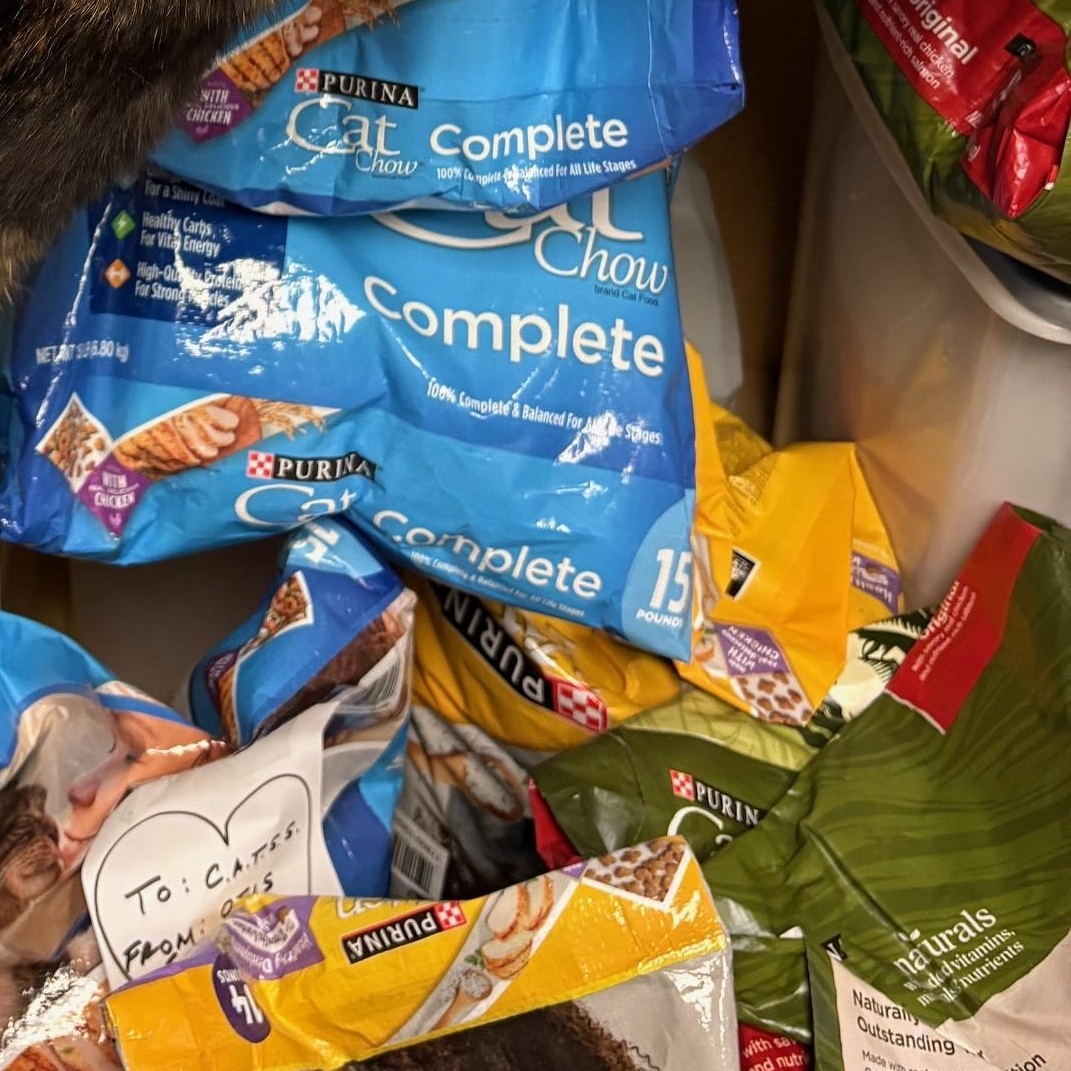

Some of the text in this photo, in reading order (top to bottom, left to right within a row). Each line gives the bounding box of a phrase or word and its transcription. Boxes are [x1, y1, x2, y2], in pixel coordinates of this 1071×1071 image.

[910, 55, 941, 89] salmon
[919, 41, 955, 79] chicken
[200, 89, 229, 103] WITH
[323, 73, 415, 107] PURINA
[186, 108, 231, 124] CHICKEN
[286, 97, 401, 156] Cat
[430, 114, 628, 161] Complete
[355, 148, 418, 175] Chow
[436, 167, 462, 180] 100%
[555, 164, 568, 177] For
[569, 162, 582, 176] All
[584, 160, 601, 175] Life
[602, 158, 637, 174] Stages
[145, 180, 160, 196] For
[162, 186, 170, 198] a
[171, 185, 201, 205] Shiny
[142, 211, 181, 232] Healthy
[140, 230, 156, 245] For
[183, 235, 221, 257] Energy
[534, 226, 669, 294] Chow
[135, 280, 185, 304] For Strong
[594, 284, 659, 307] brand Cat Food
[363, 276, 665, 377] Complete
[426, 379, 457, 404] 100%
[459, 391, 511, 414] Complete
[521, 404, 566, 428] Balanced
[566, 412, 583, 430] For
[625, 424, 662, 446] Stages
[278, 452, 373, 480] PURINA
[94, 491, 136, 509] CHICKEN
[372, 509, 603, 601] Complete
[649, 547, 693, 614] 15
[442, 587, 546, 705] PURIN
[695, 779, 759, 827] PURIN
[347, 911, 439, 958] PURINA
[950, 929, 1017, 972] vitamins,
[959, 940, 1025, 989] nutrients
[229, 983, 264, 1025] 14
[742, 1038, 773, 1059] with
[857, 1016, 955, 1056] Outstanding
[862, 1050, 887, 1069] Made
